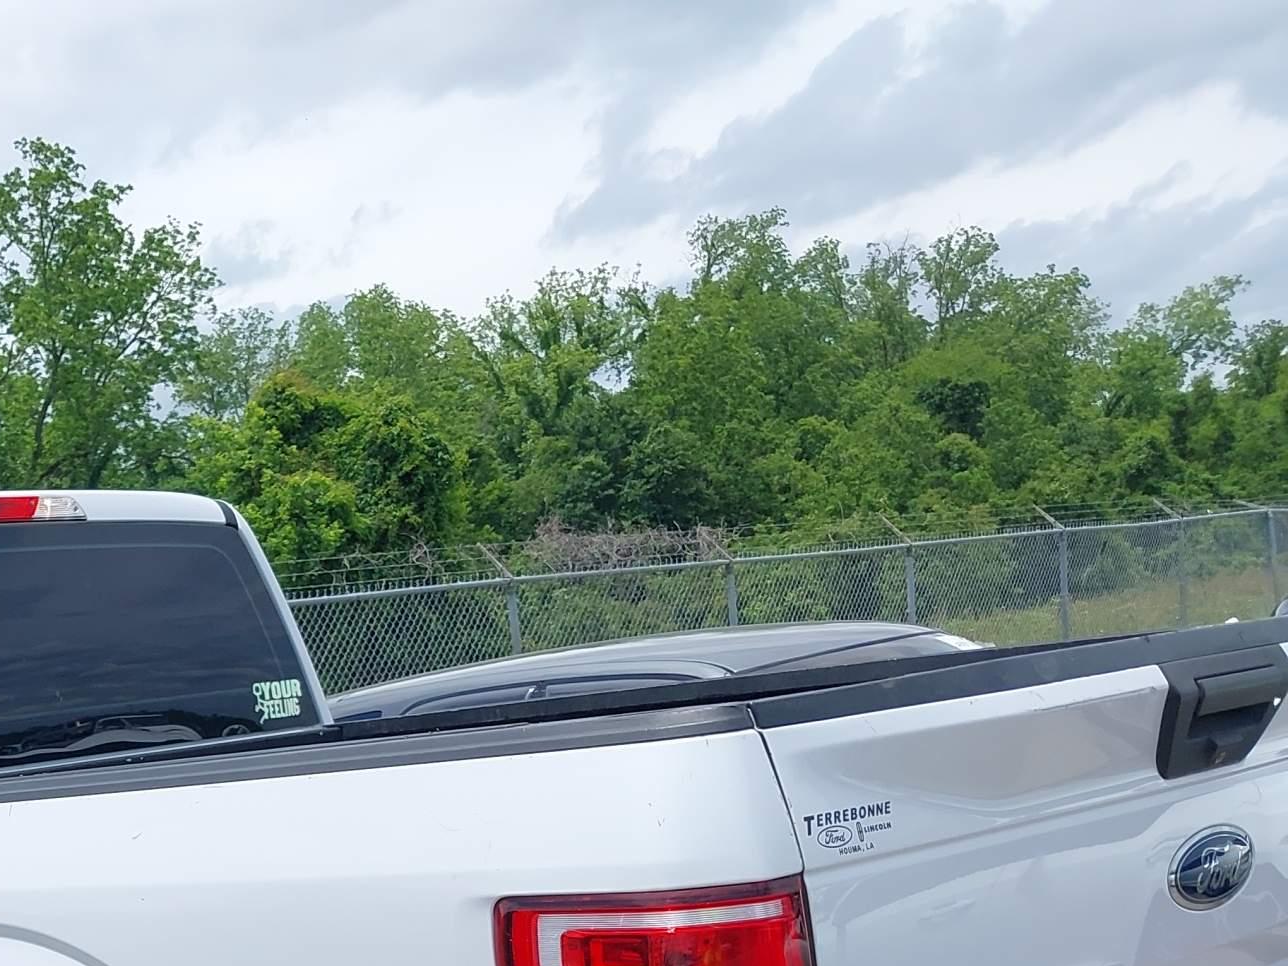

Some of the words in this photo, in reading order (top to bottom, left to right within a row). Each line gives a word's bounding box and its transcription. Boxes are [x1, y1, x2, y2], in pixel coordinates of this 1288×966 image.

[261, 679, 302, 700] YOUR
[803, 801, 891, 836] TERREBONNE
[864, 822, 892, 833] LINCOLN
[839, 846, 865, 855] HOUMA,
[866, 842, 875, 850] LA
